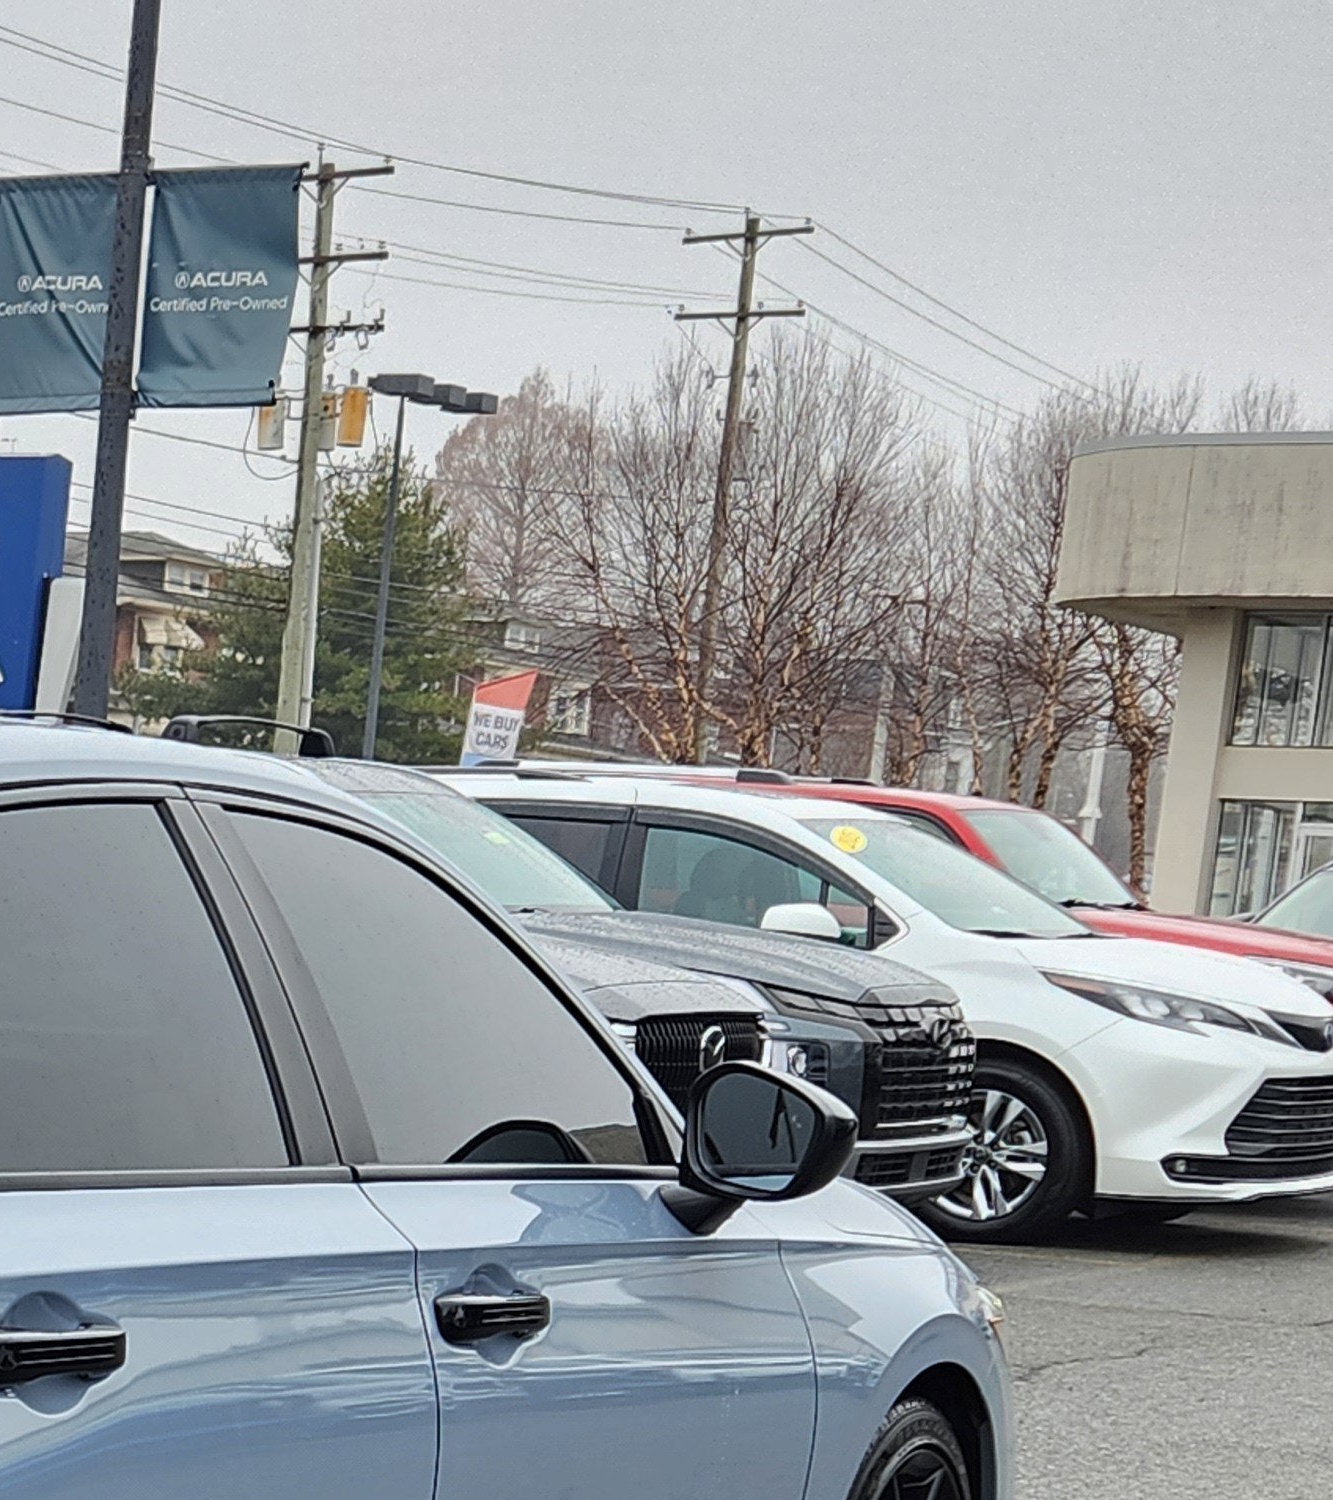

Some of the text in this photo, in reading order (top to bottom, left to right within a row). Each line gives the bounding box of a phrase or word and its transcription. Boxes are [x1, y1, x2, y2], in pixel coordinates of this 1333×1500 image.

[31, 275, 104, 291] ACURA
[190, 270, 269, 288] ACURA
[150, 295, 289, 312] Certified Pre-Owned
[494, 715, 520, 731] BUY
[475, 731, 509, 749] CARS
